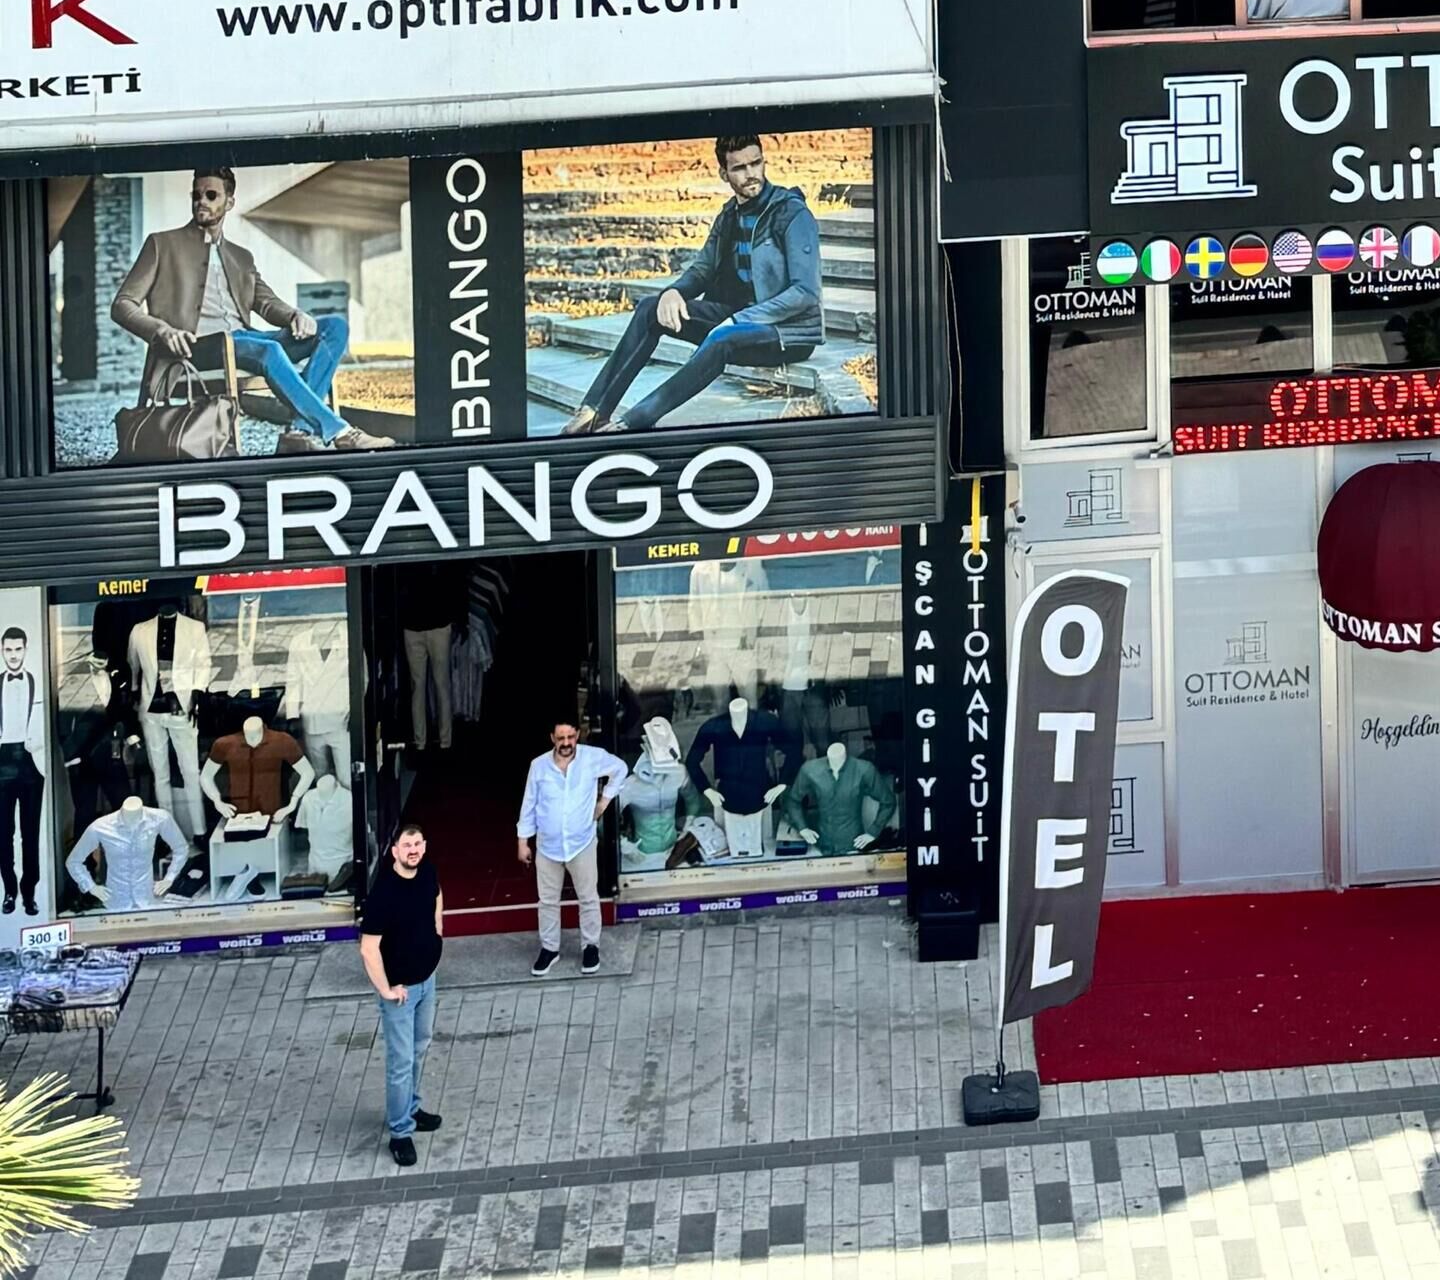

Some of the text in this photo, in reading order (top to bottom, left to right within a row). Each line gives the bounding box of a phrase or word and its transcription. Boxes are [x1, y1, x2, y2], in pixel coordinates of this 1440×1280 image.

[445, 157, 492, 439] BRANGO
[1034, 288, 1137, 312] OTTOMAN
[1174, 424, 1253, 452] SUIT
[159, 446, 775, 567] BRANGO
[648, 541, 700, 559] KEMER
[962, 548, 993, 743] OTTOMAN
[1184, 665, 1310, 694] OTTOMAN
[914, 521, 940, 867] İŞCAN GİYİM
[1186, 688, 1310, 708] Suit Residence & Hotel
[1029, 602, 1106, 992] OTEL
[776, 894, 818, 905] WORLD
[837, 889, 879, 900] WORLD
[637, 906, 680, 918] WORLD
[700, 901, 742, 912] WORLD
[29, 932, 52, 947] 300
[218, 937, 263, 950] WORLD
[282, 932, 326, 944] WORLD
